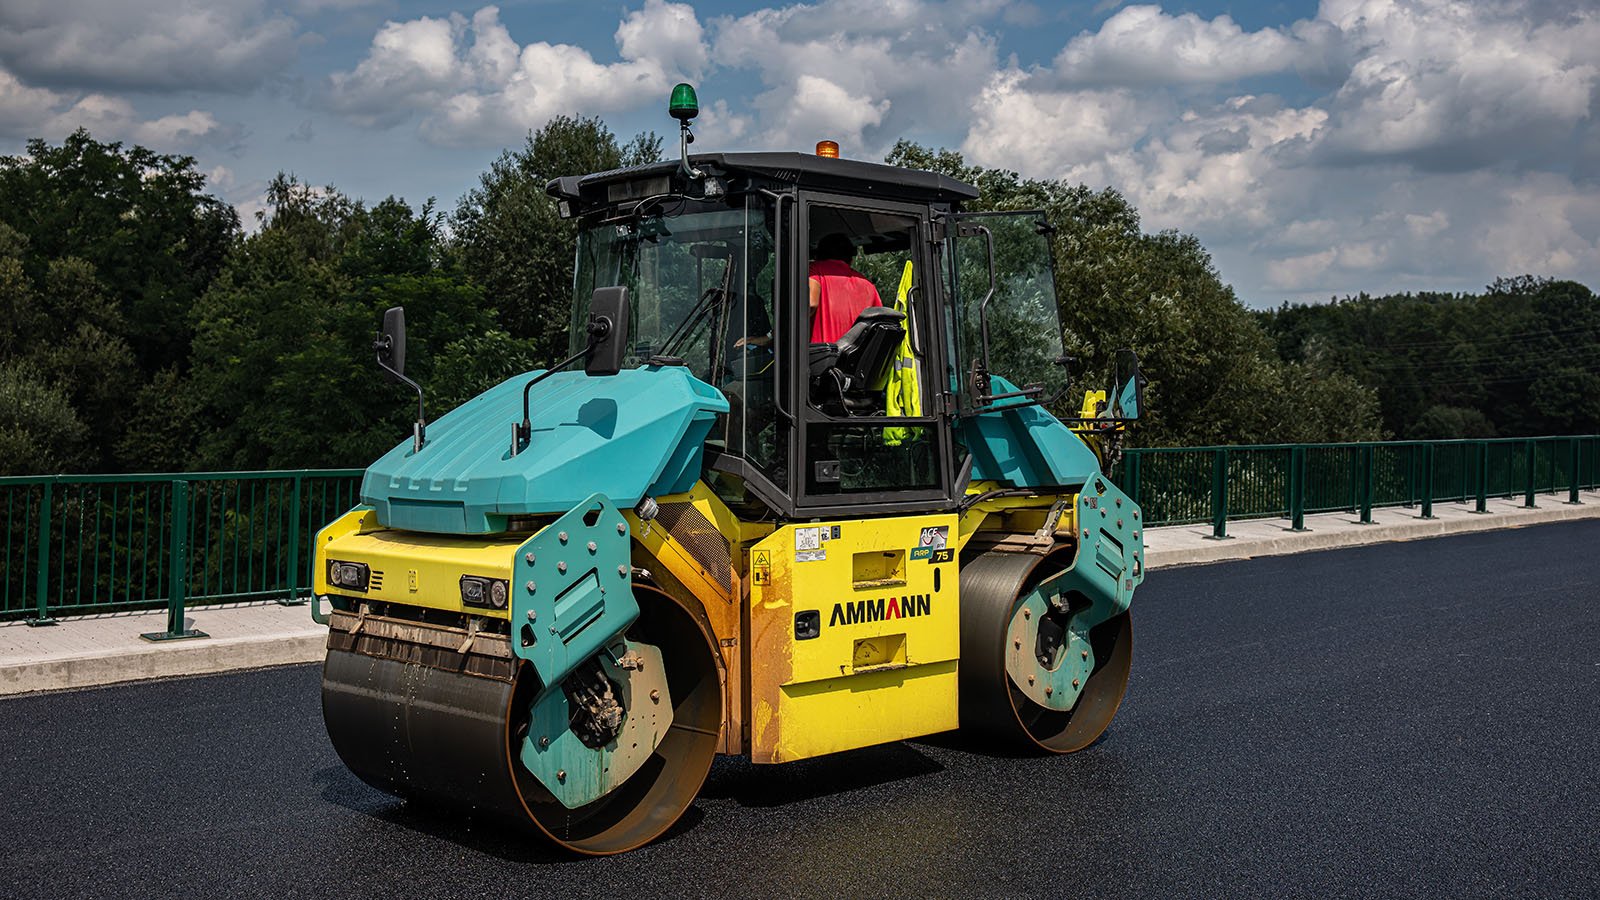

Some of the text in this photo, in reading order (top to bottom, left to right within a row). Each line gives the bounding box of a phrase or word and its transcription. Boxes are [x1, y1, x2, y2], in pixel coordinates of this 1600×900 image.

[920, 527, 938, 539] ACE
[913, 549, 930, 557] ARP
[936, 551, 949, 561] 75
[829, 594, 930, 627] AMMANN
